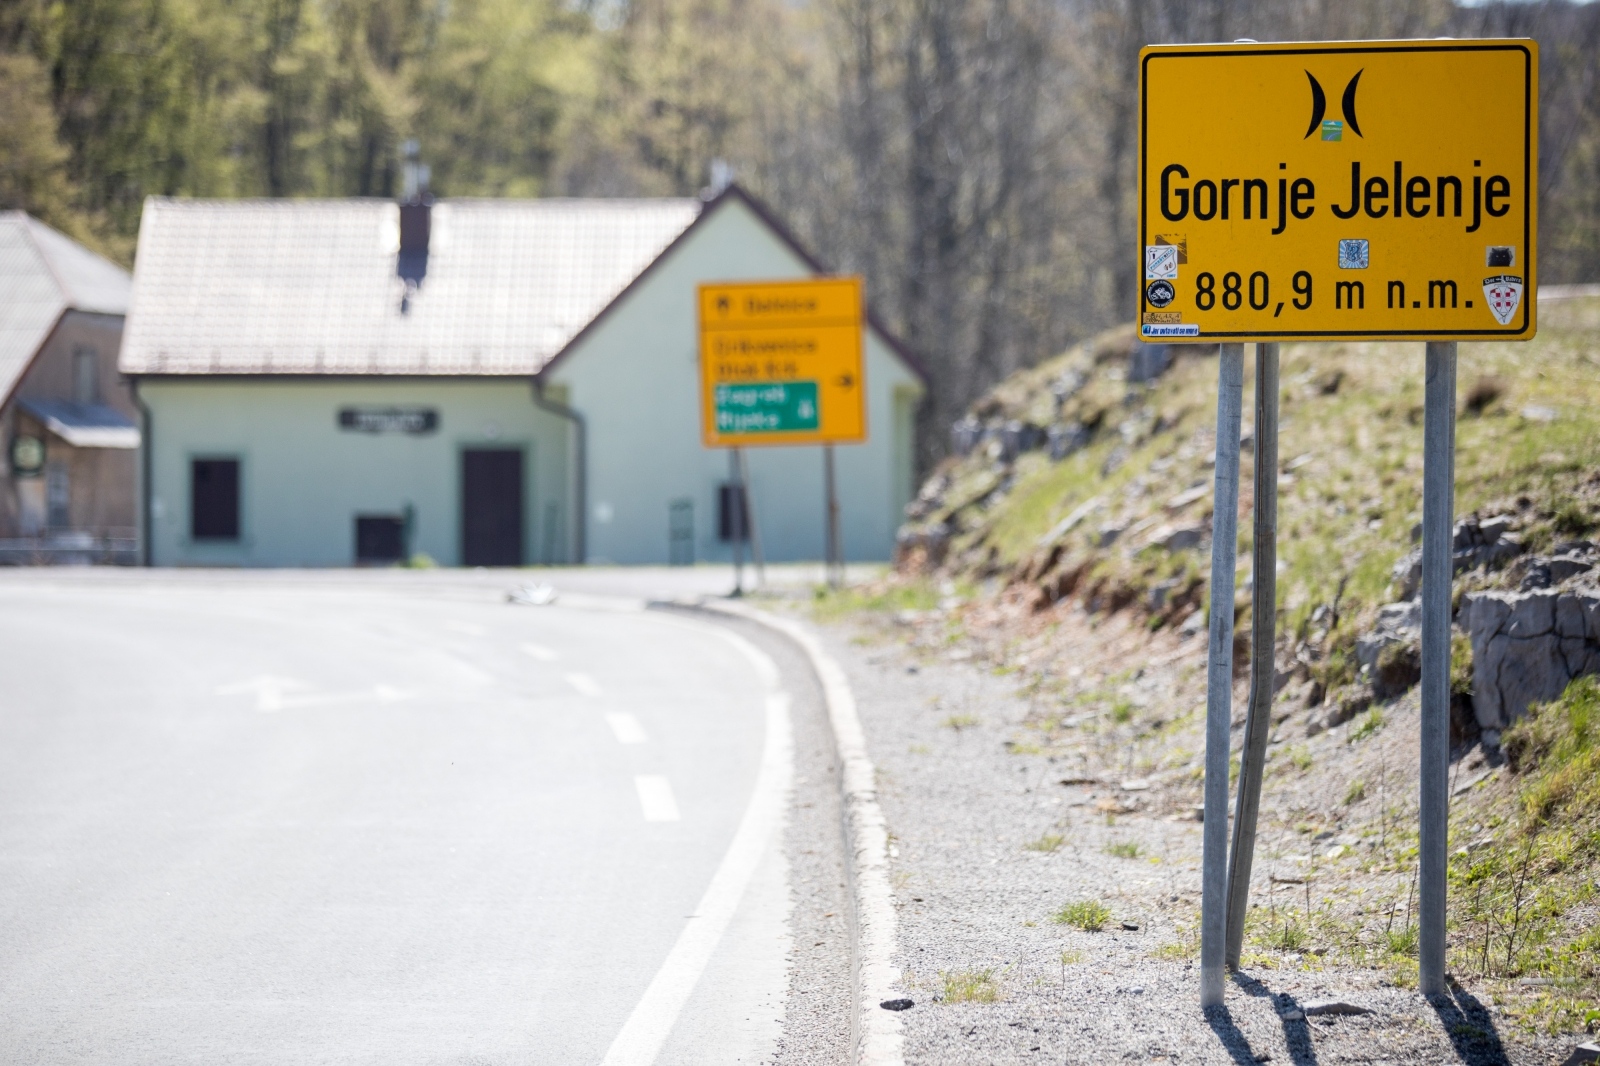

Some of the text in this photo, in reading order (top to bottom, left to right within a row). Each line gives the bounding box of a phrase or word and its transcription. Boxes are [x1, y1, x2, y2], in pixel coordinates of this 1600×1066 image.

[1160, 160, 1511, 235] Gornje Jelenje
[1195, 271, 1312, 317] 880,9
[1335, 280, 1365, 309] m
[1387, 280, 1473, 309] n.m.
